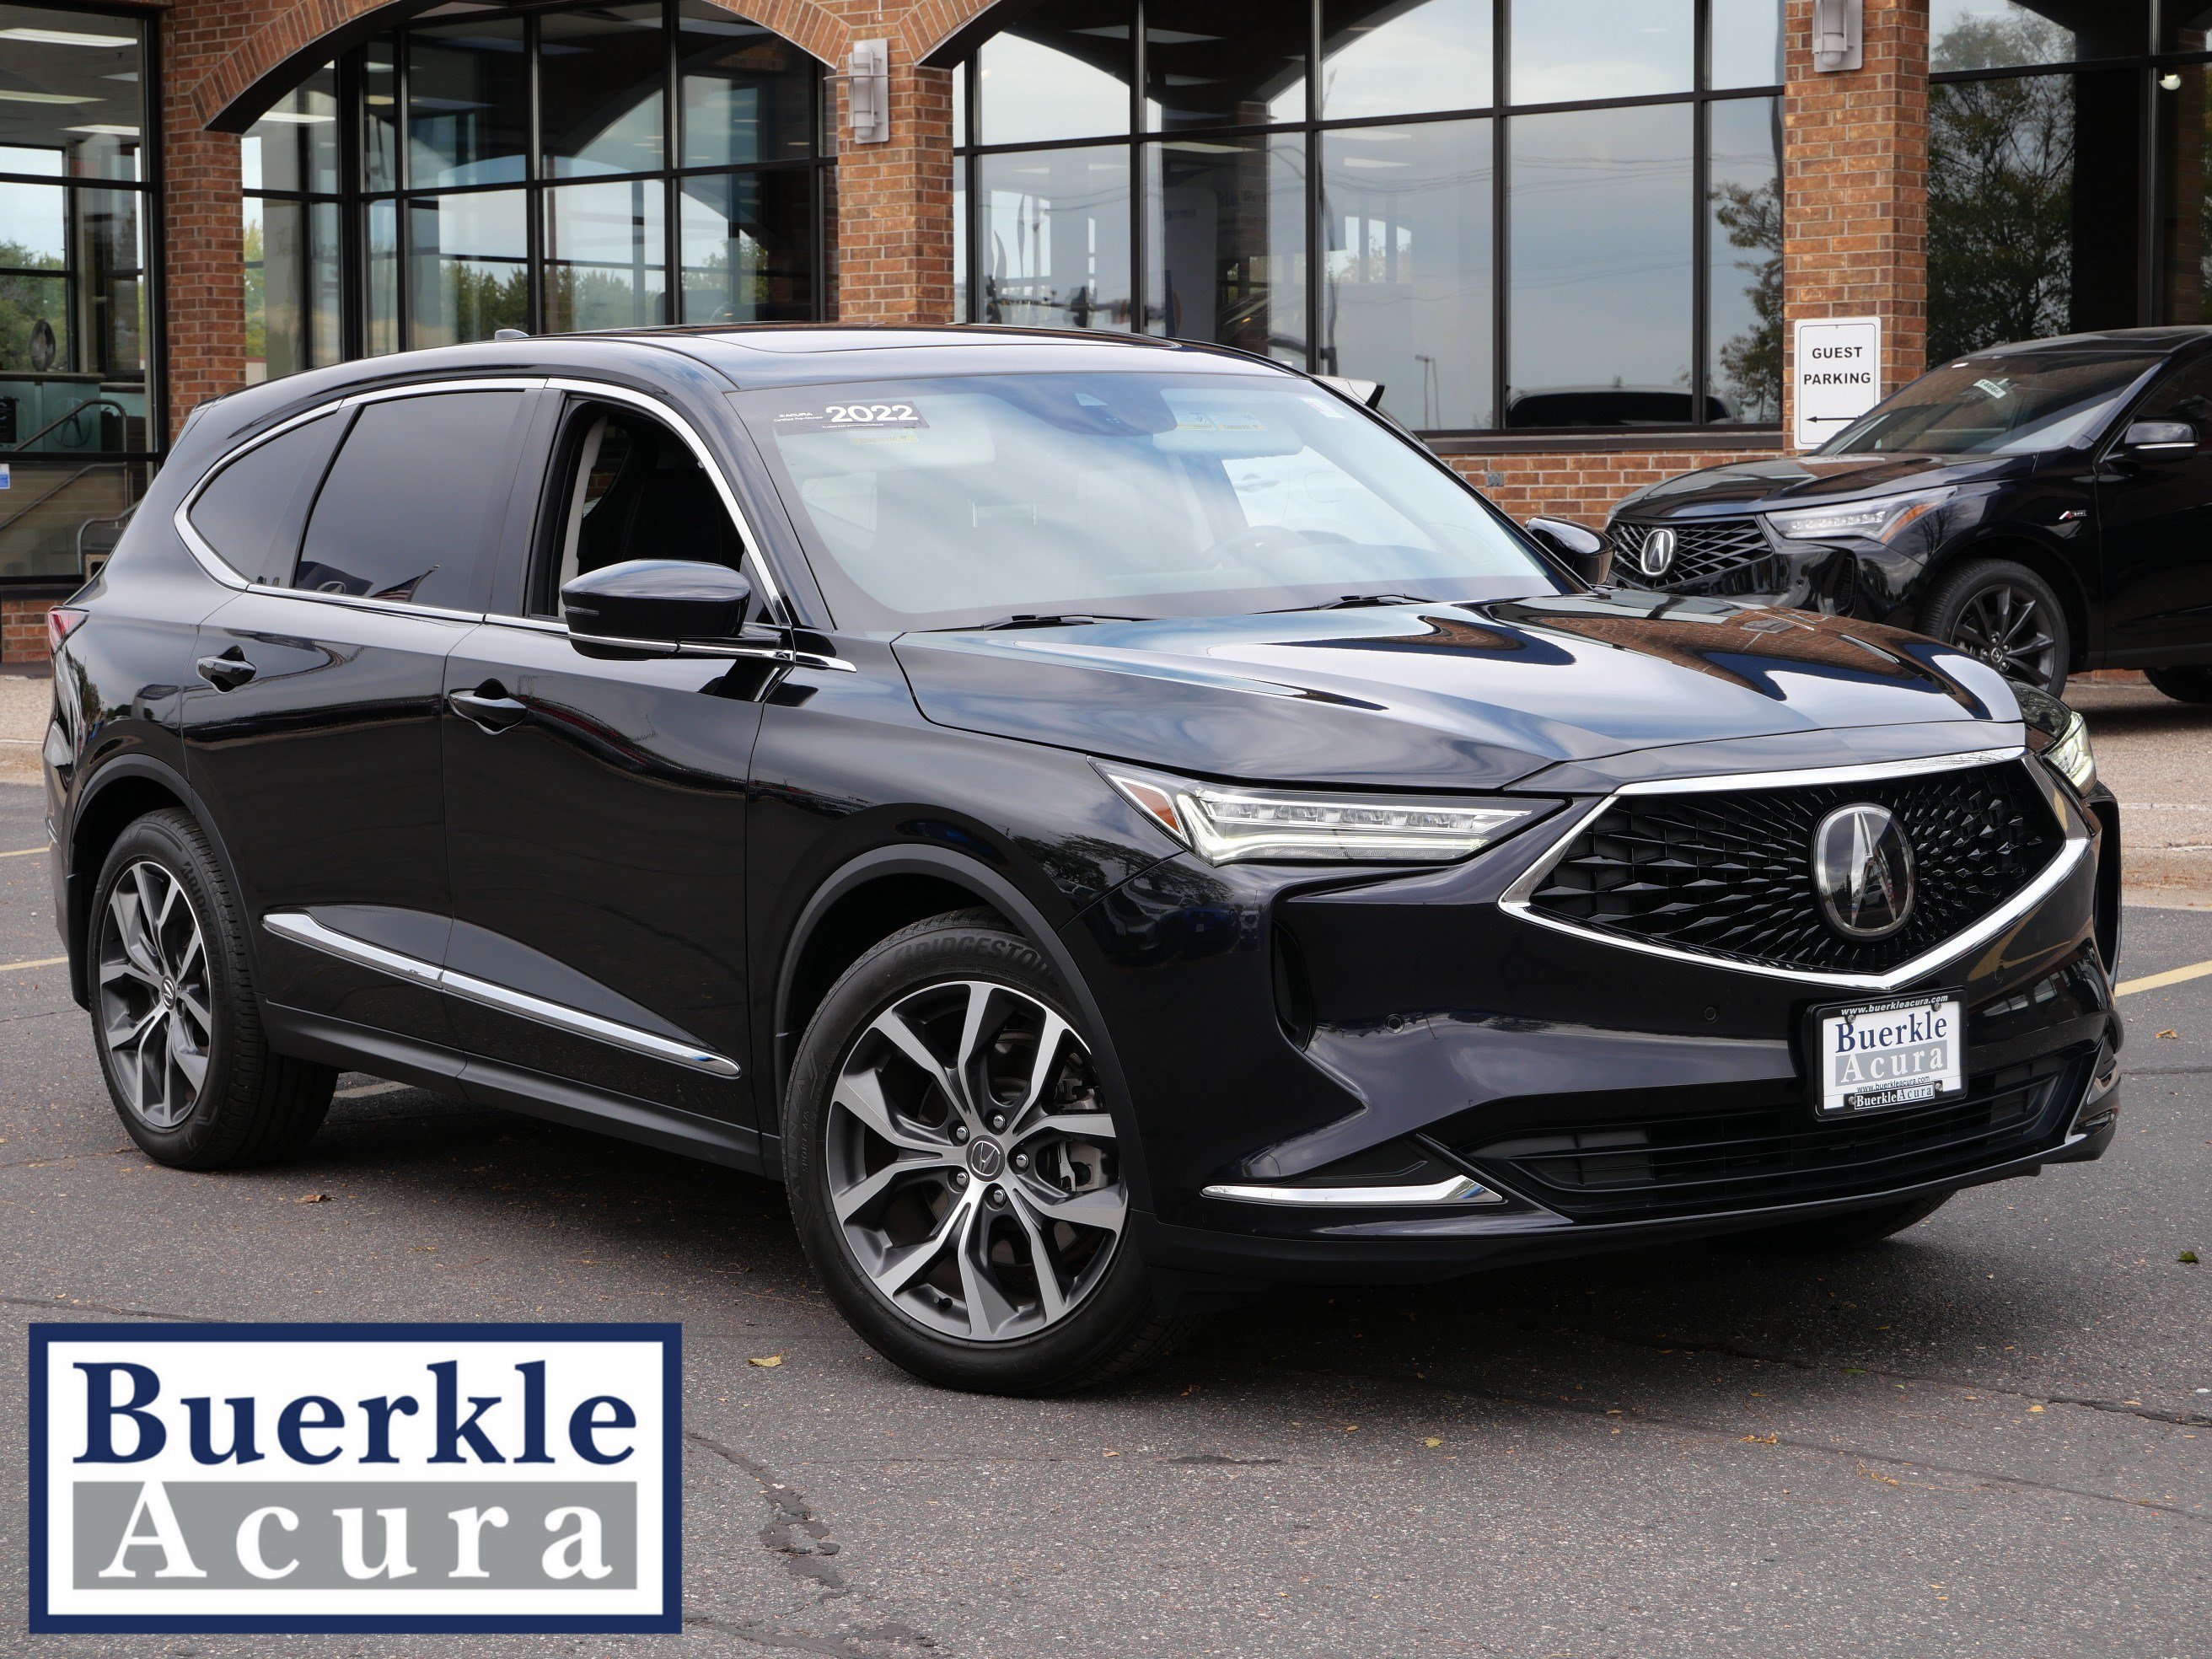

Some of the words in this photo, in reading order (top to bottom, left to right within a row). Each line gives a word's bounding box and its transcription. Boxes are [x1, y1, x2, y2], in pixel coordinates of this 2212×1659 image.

[1812, 346, 1863, 359] GUEST
[1803, 372, 1871, 385] PARKING
[825, 405, 919, 422] 2022
[894, 936, 1057, 985] BRIDGESTON
[1840, 995, 1949, 1016] www.buerkleacura.com
[1834, 1010, 1948, 1054] Buerkle
[1840, 1046, 1945, 1083] Acura
[1856, 1075, 1930, 1093] www.buerkleacura.com
[1855, 1091, 1897, 1108] Buerkle
[1898, 1086, 1933, 1101] Acura
